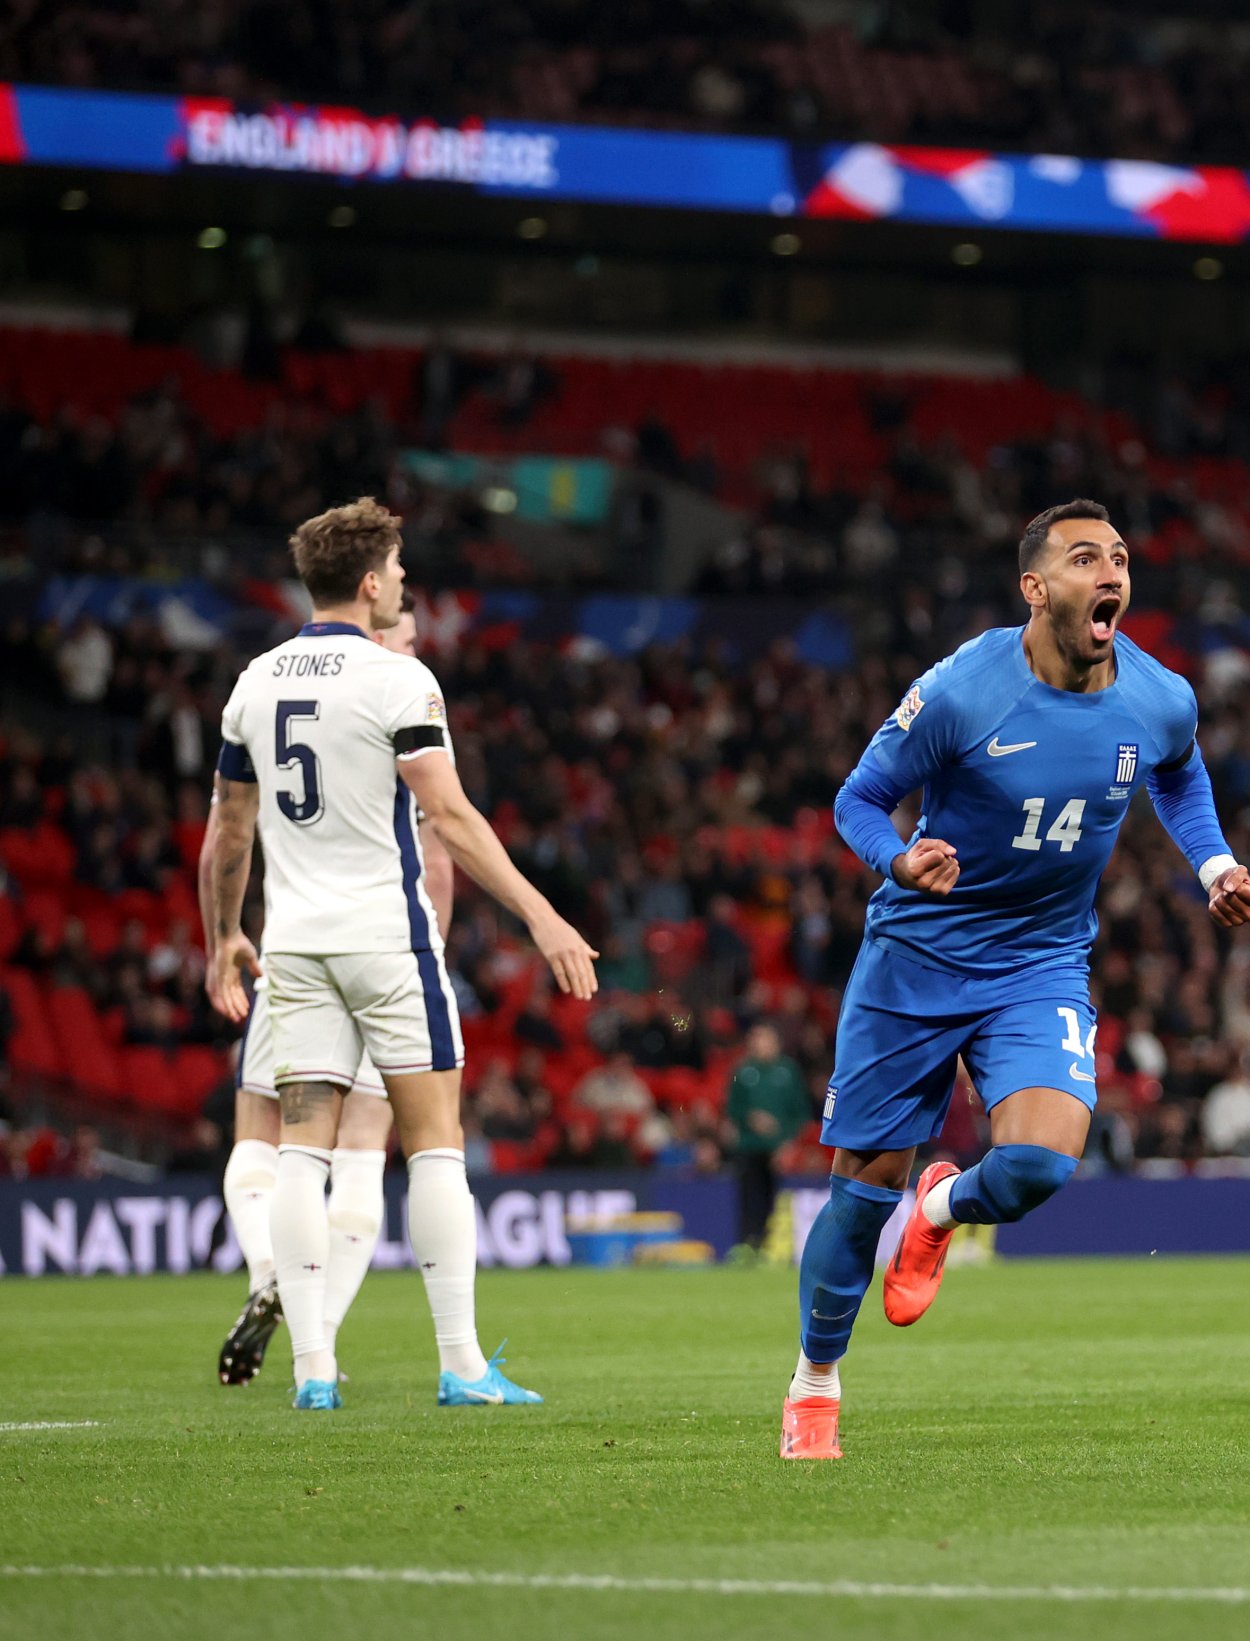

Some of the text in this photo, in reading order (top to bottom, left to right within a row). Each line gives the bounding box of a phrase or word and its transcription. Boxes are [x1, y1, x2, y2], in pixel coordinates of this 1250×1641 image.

[187, 109, 375, 175] ENGLAND
[406, 125, 560, 189] GREECE
[272, 653, 346, 677] STONES
[275, 699, 325, 827] 5
[1011, 797, 1088, 852] 14
